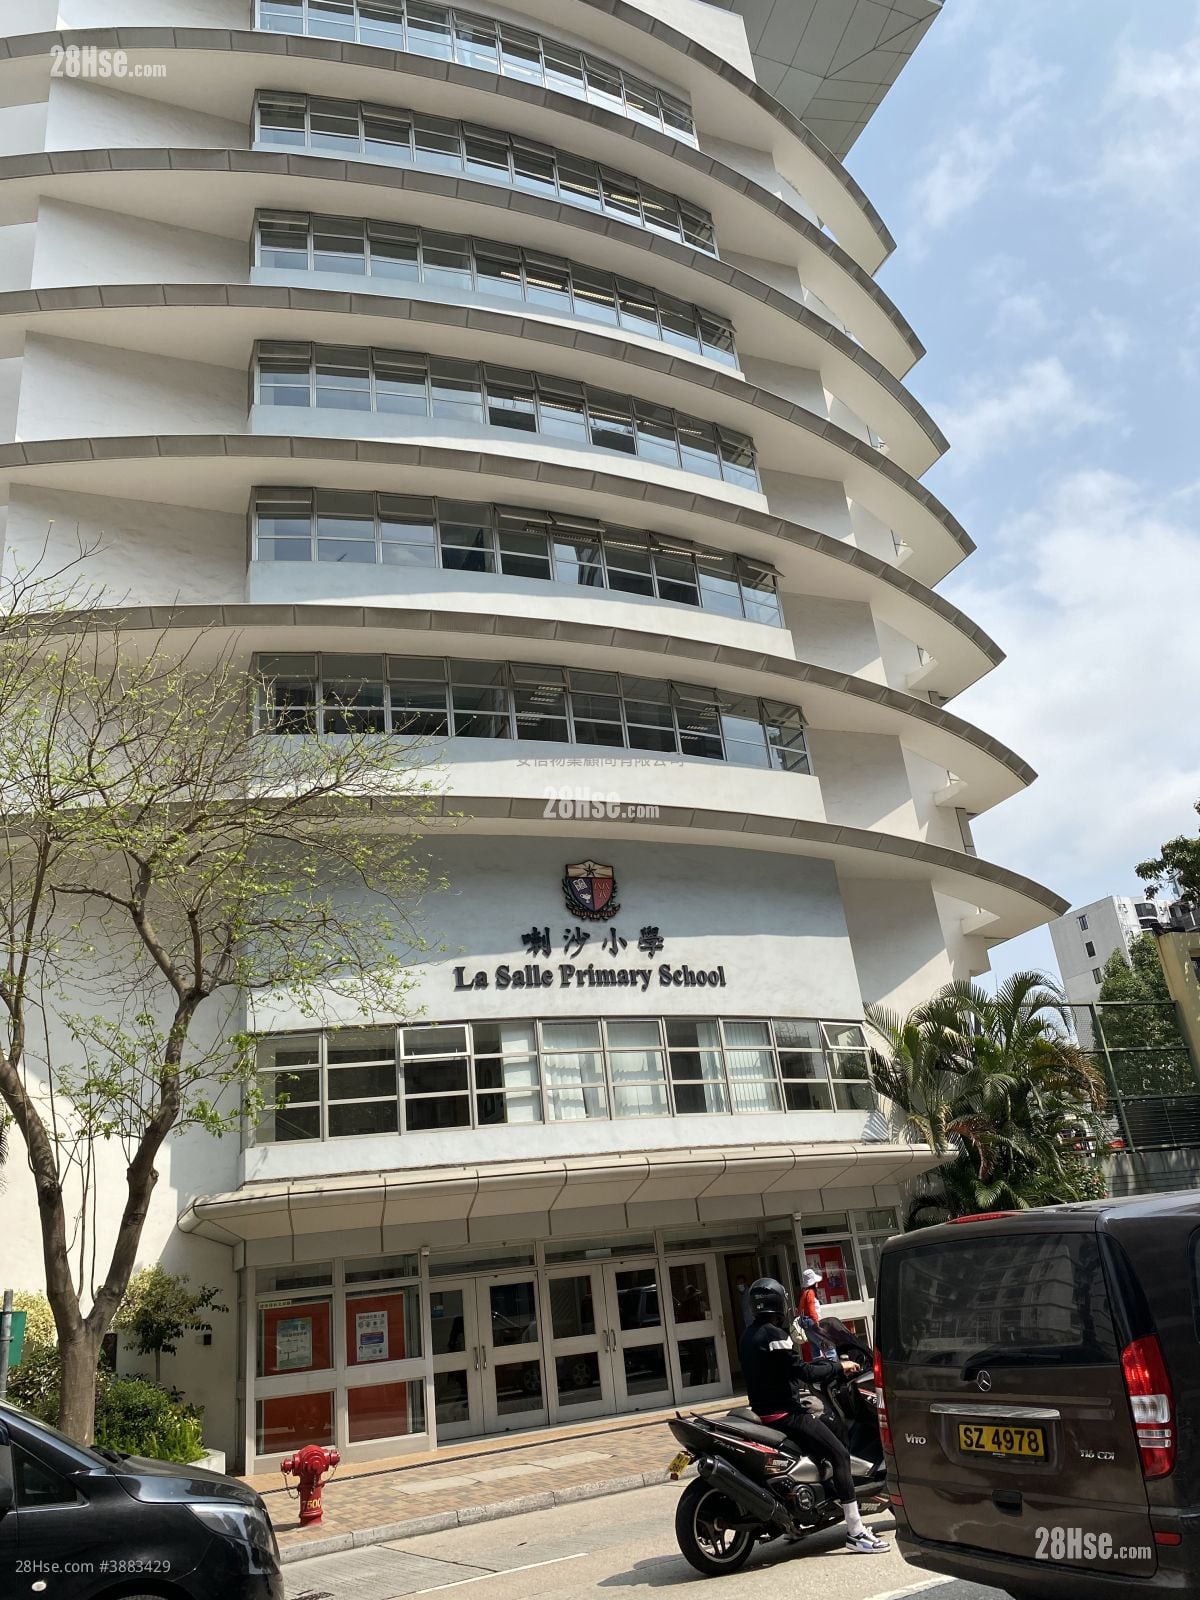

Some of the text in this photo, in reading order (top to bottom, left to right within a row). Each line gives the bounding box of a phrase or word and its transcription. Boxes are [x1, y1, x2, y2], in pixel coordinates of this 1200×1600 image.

[521, 926, 664, 958] 喇沙小學
[453, 963, 727, 992] La Salle Primary School
[963, 1427, 1040, 1453] SZ 4978
